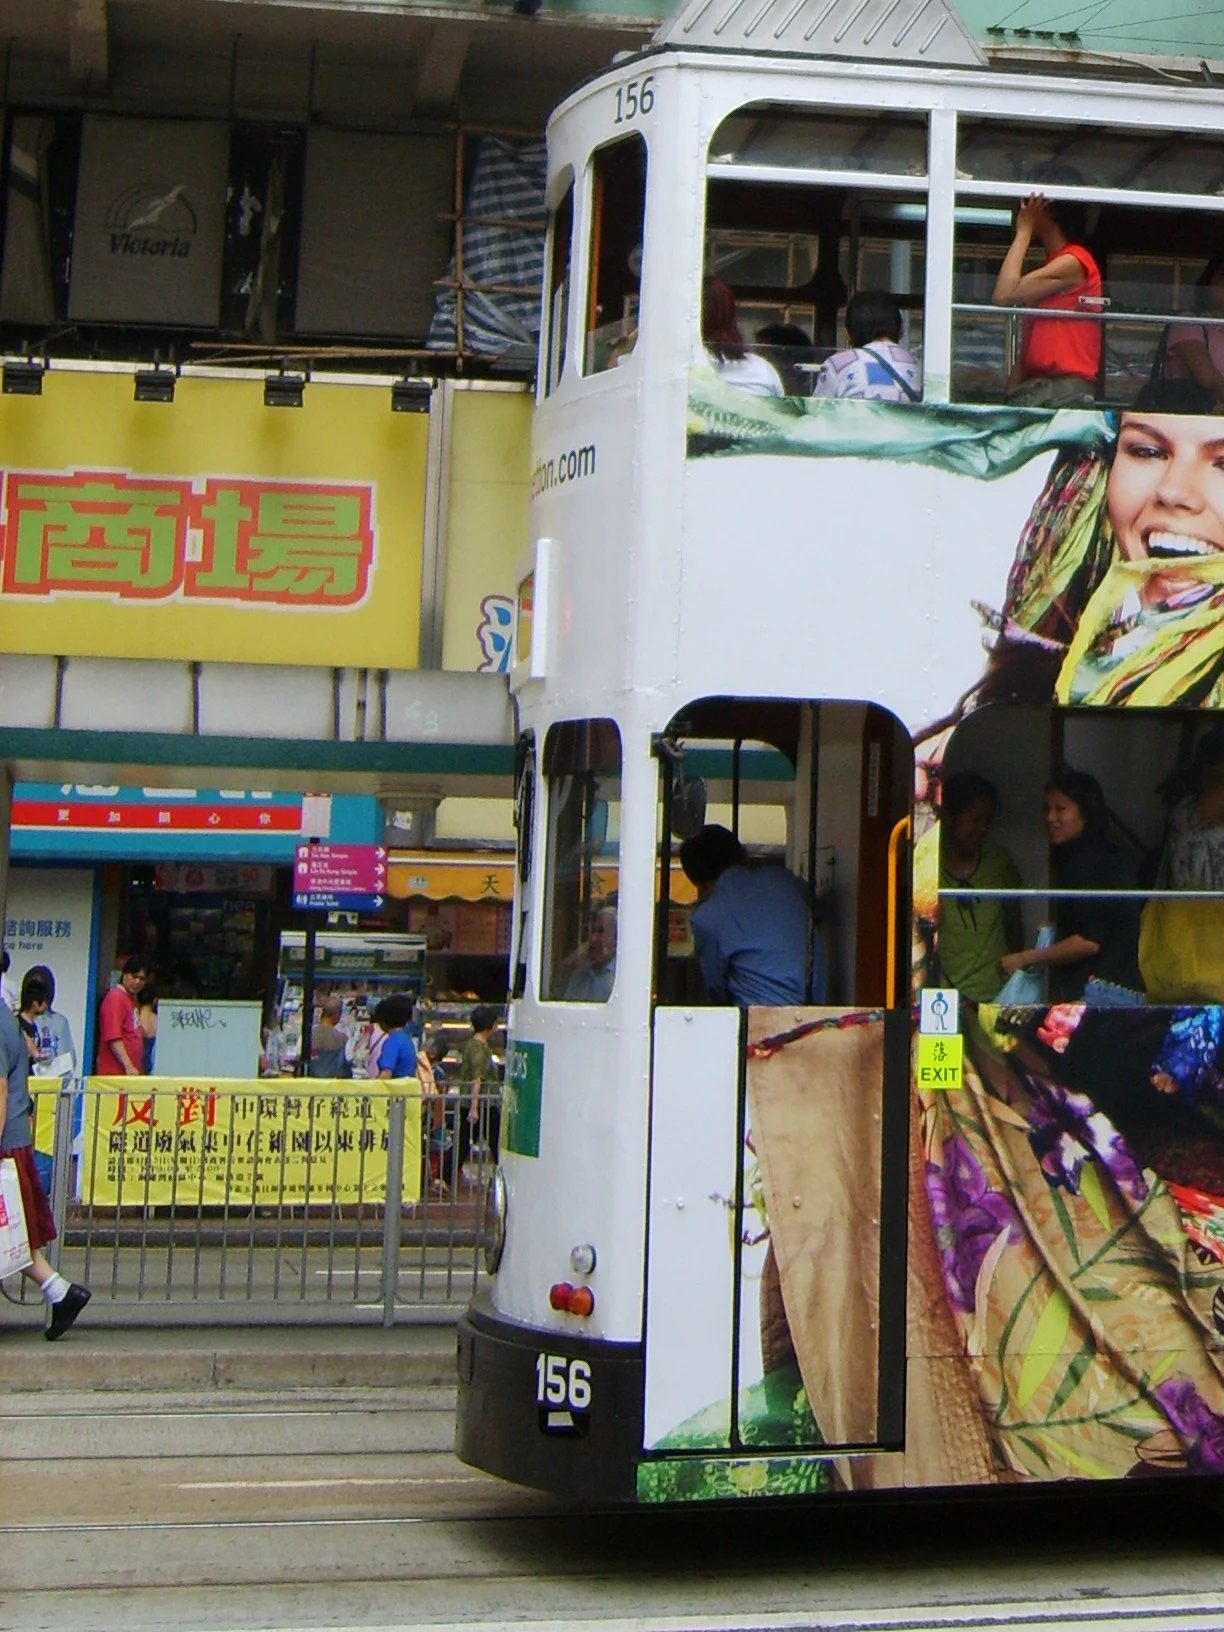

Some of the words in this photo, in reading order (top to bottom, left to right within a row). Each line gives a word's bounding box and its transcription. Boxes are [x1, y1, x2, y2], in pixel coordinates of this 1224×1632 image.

[614, 76, 655, 124] 156
[108, 232, 191, 258] Victoria
[3, 471, 374, 606] 商場
[933, 1041, 948, 1061] 落
[920, 1067, 959, 1081] EXIT
[112, 1087, 220, 1128] 反對
[535, 1352, 592, 1408] 156
